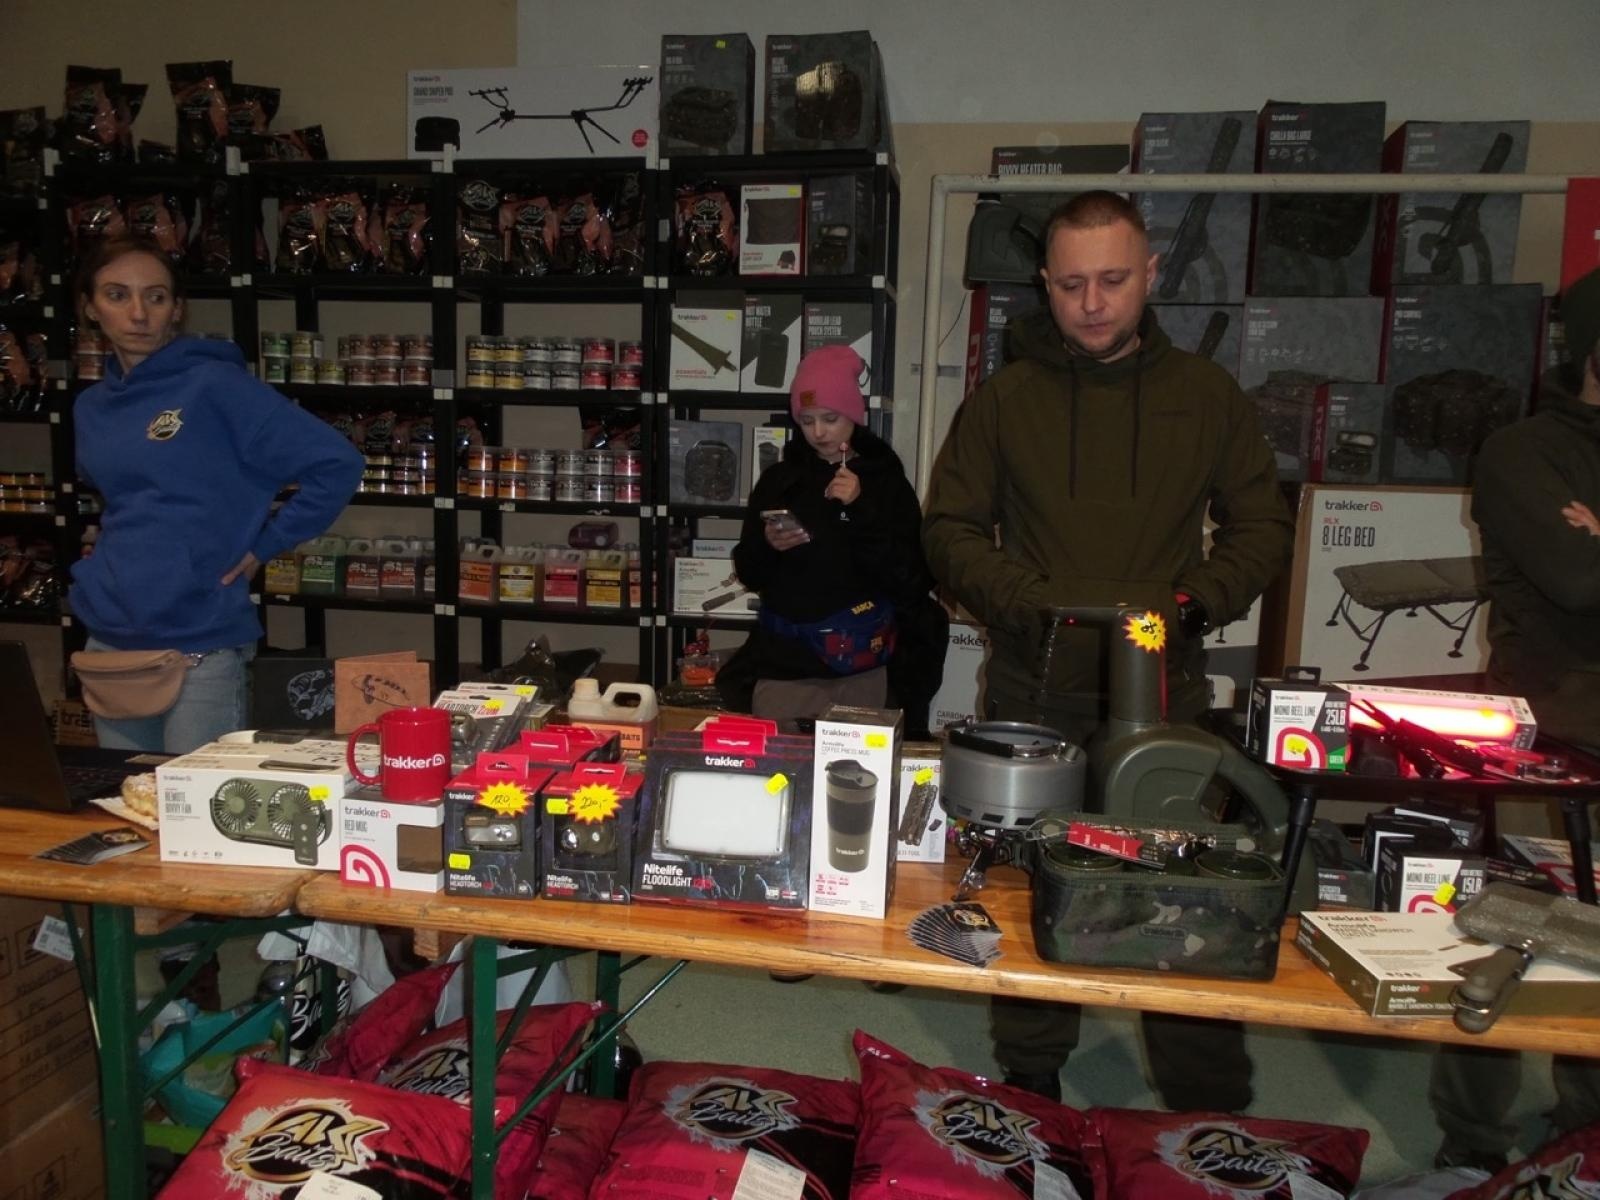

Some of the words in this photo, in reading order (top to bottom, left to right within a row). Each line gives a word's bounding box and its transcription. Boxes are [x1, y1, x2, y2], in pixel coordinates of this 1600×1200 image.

[1324, 500, 1370, 512] trakker
[1322, 526, 1330, 546] 8
[1332, 526, 1352, 547] LEG
[1354, 527, 1376, 548] BED
[1273, 705, 1291, 716] MONO
[1291, 705, 1304, 717] REEL
[1304, 705, 1316, 717] LINE
[1325, 708, 1346, 726] 25LB
[822, 729, 851, 737] trakker
[384, 753, 432, 770] trakker
[705, 755, 745, 768] trakker
[448, 792, 475, 801] trakker
[344, 806, 380, 818] trakker
[643, 863, 685, 877] Nitelife
[450, 873, 476, 882] Nitelife
[546, 874, 573, 883] Nitelife
[642, 874, 693, 888] FLOODLIGHT
[1406, 871, 1423, 883] MONO
[450, 881, 482, 889] HEADTORCH
[1390, 984, 1420, 993] trakker
[690, 1101, 771, 1130] Baits
[1190, 1147, 1286, 1177] Baits
